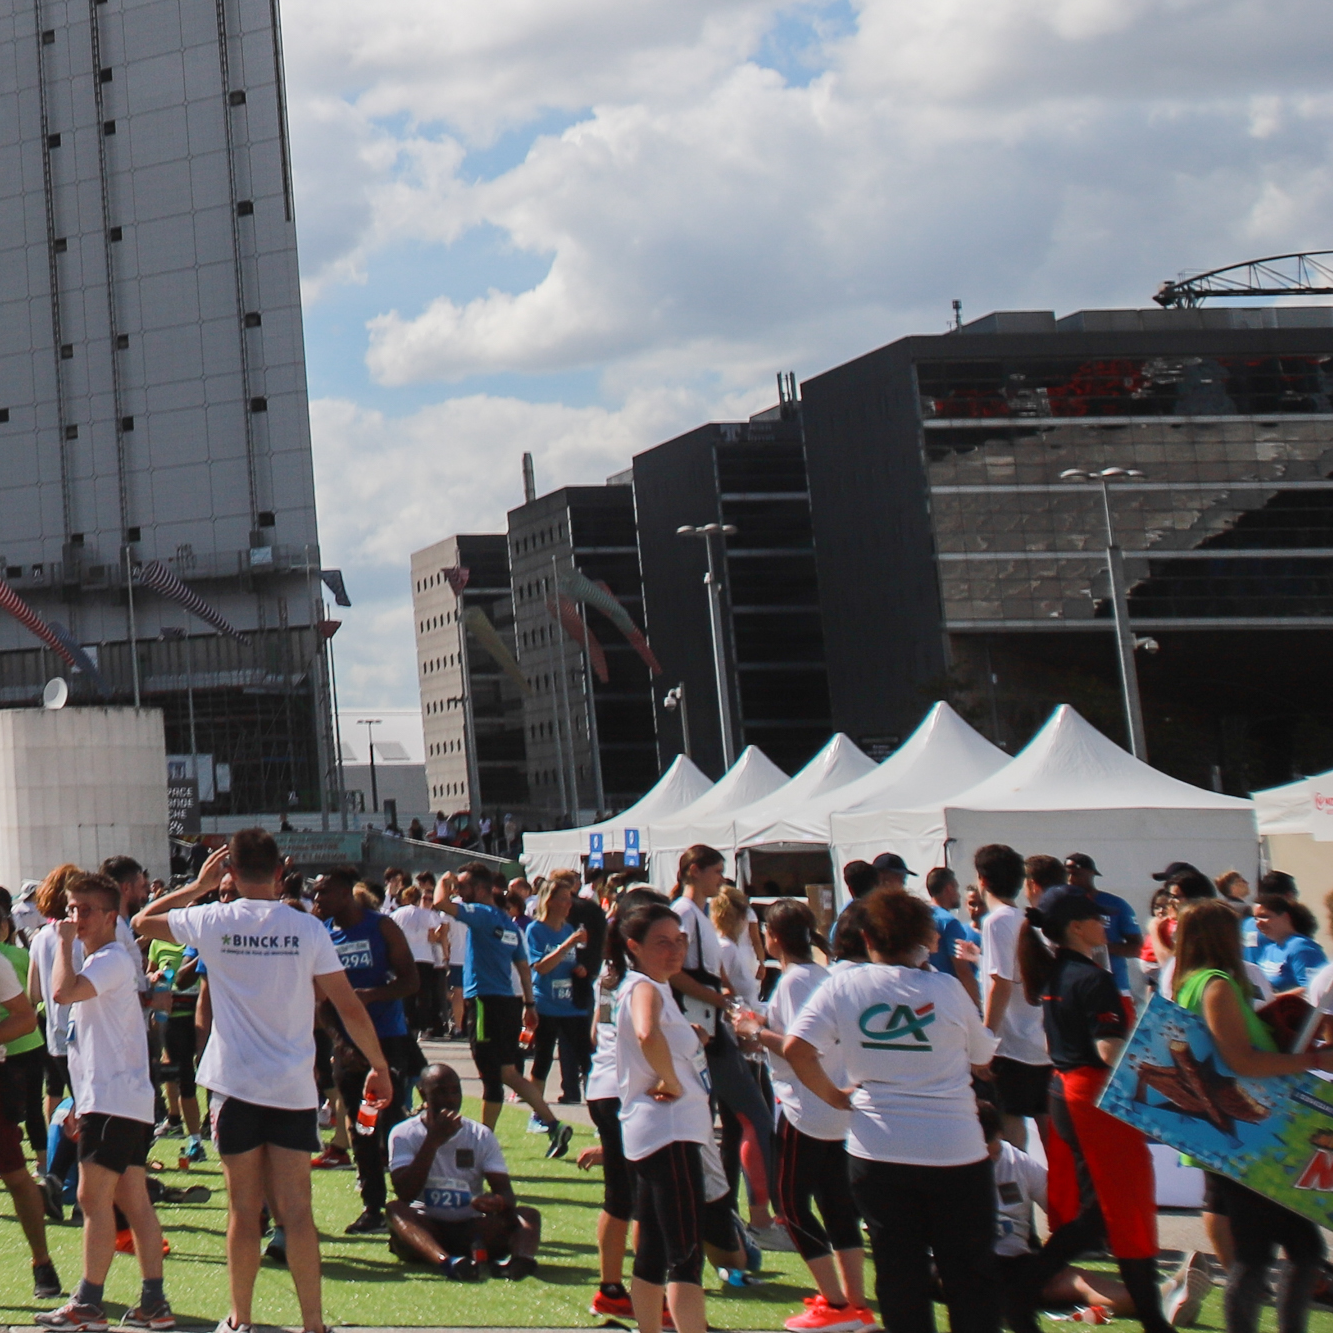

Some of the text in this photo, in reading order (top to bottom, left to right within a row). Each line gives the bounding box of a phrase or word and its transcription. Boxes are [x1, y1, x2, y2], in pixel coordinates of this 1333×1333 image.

[233, 934, 299, 948] BINCK.FR
[340, 952, 370, 968] 294
[859, 1002, 936, 1042] CA
[430, 1191, 462, 1207] 921
